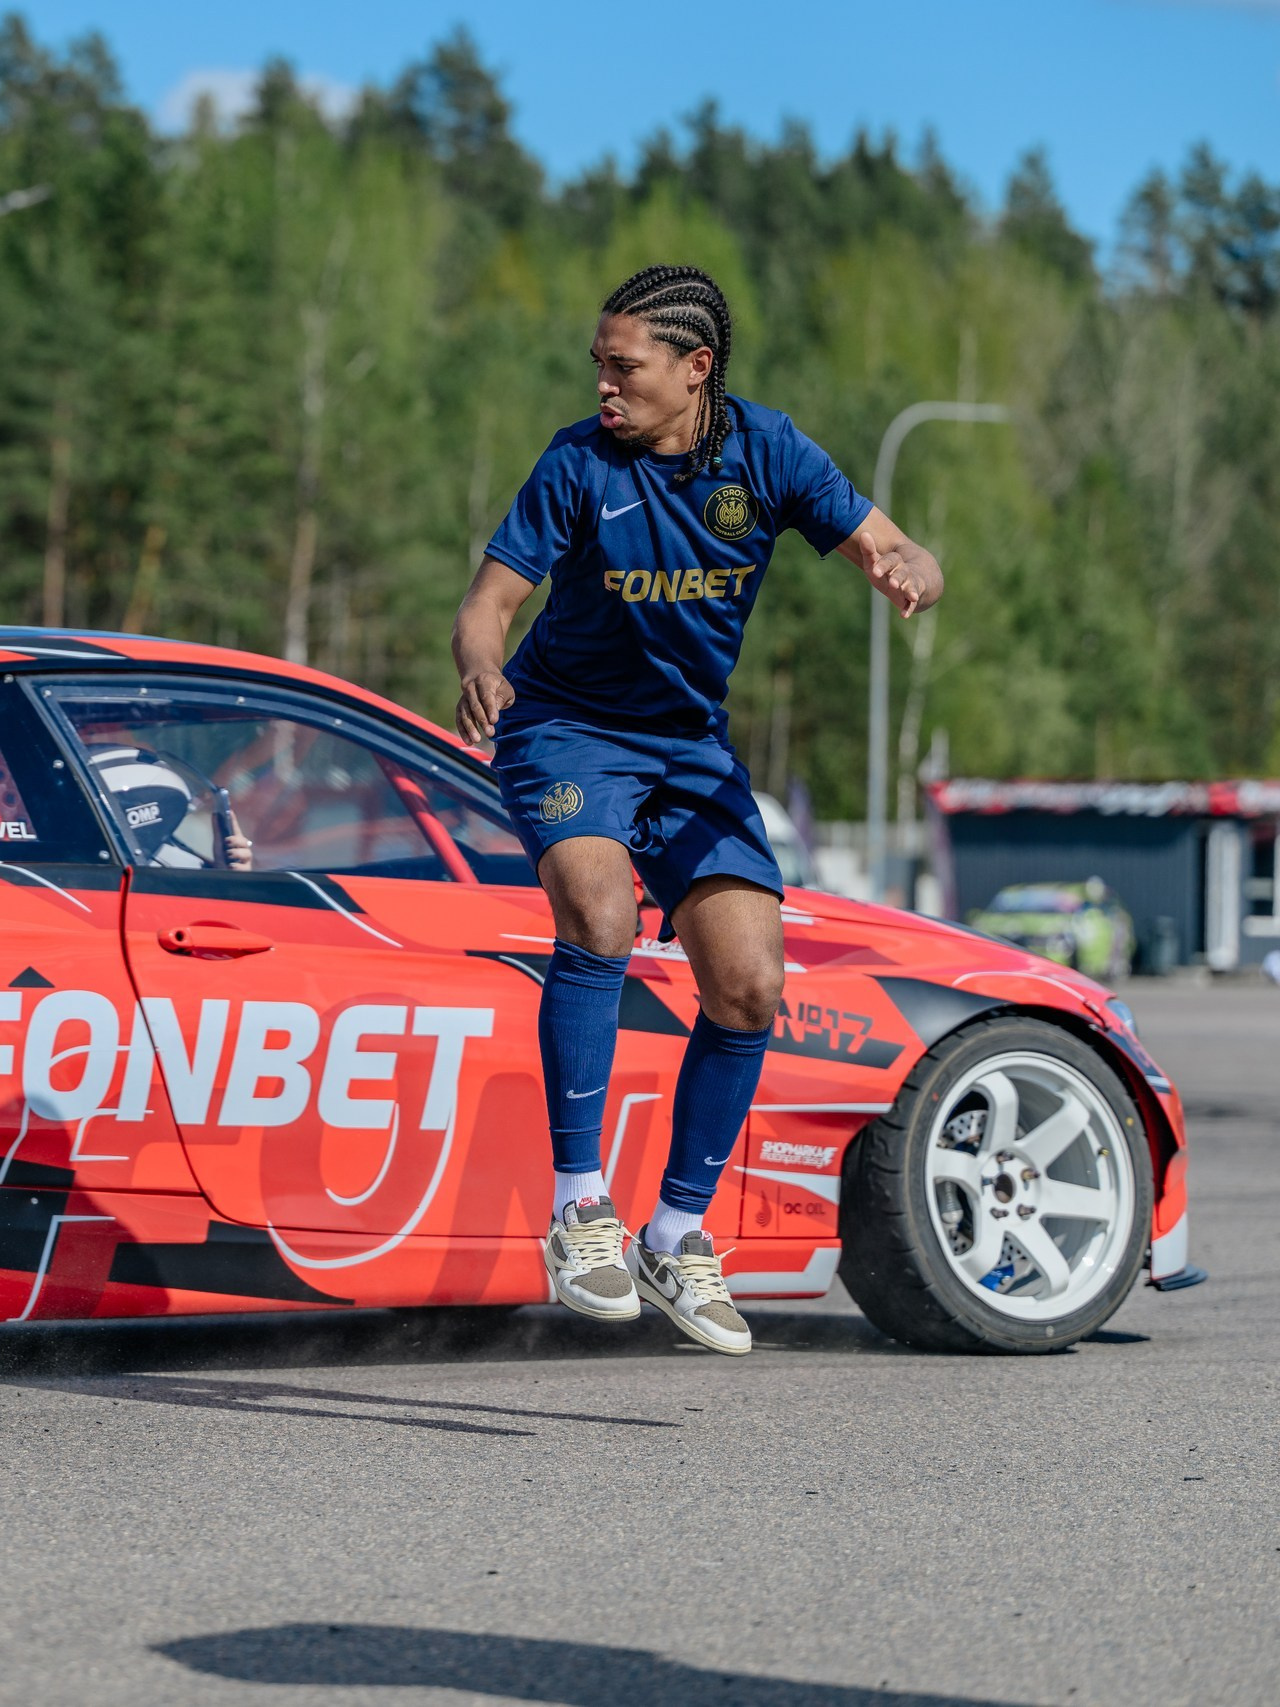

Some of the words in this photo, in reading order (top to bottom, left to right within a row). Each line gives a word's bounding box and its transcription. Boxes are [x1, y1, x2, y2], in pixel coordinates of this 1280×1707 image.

[714, 525, 735, 536] FOOTBALL
[603, 564, 757, 603] FONBET
[126, 805, 160, 825] OMP
[806, 1202, 826, 1215] OIL
